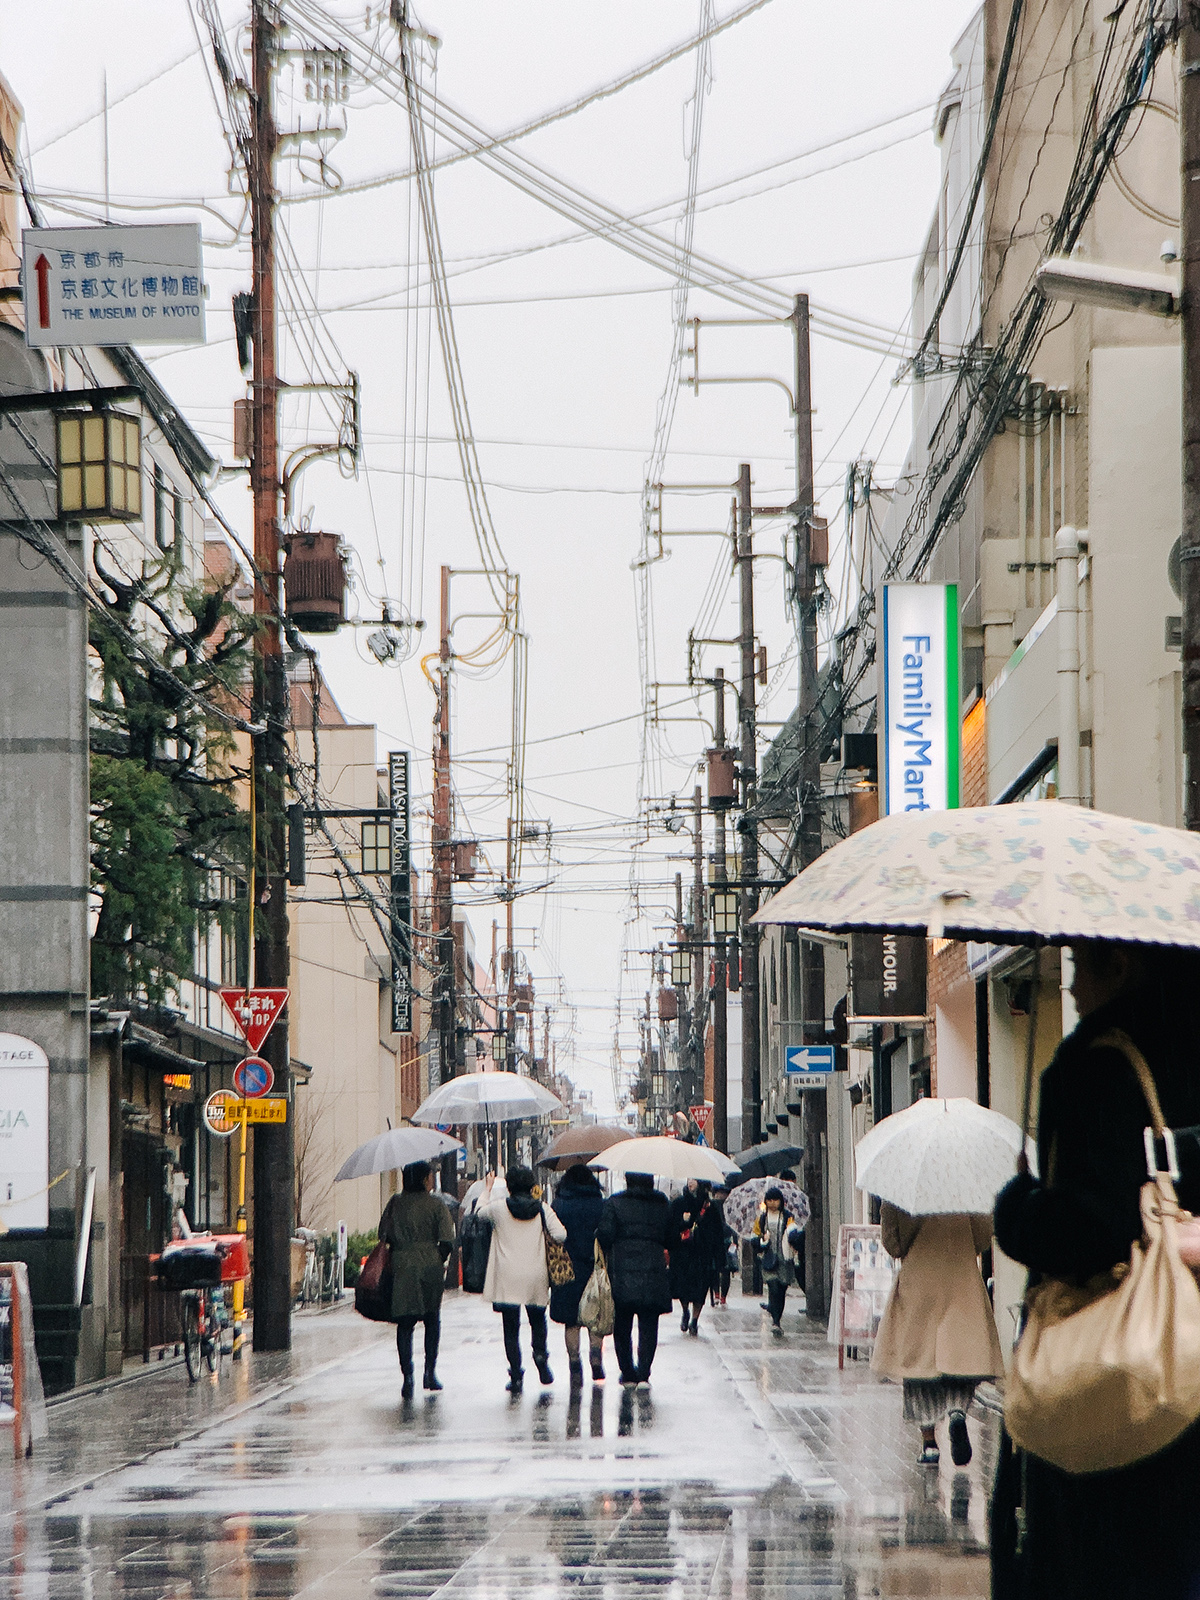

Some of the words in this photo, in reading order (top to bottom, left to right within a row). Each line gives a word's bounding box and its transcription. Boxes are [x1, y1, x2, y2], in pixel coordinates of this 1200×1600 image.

[60, 251, 124, 269] 京都府
[60, 275, 199, 299] 京都文化博物館
[61, 308, 85, 321] THE
[89, 307, 137, 320] MUSEUM
[142, 306, 157, 318] OF
[162, 305, 200, 317] KYOTO
[895, 635, 932, 812] FamilyMart
